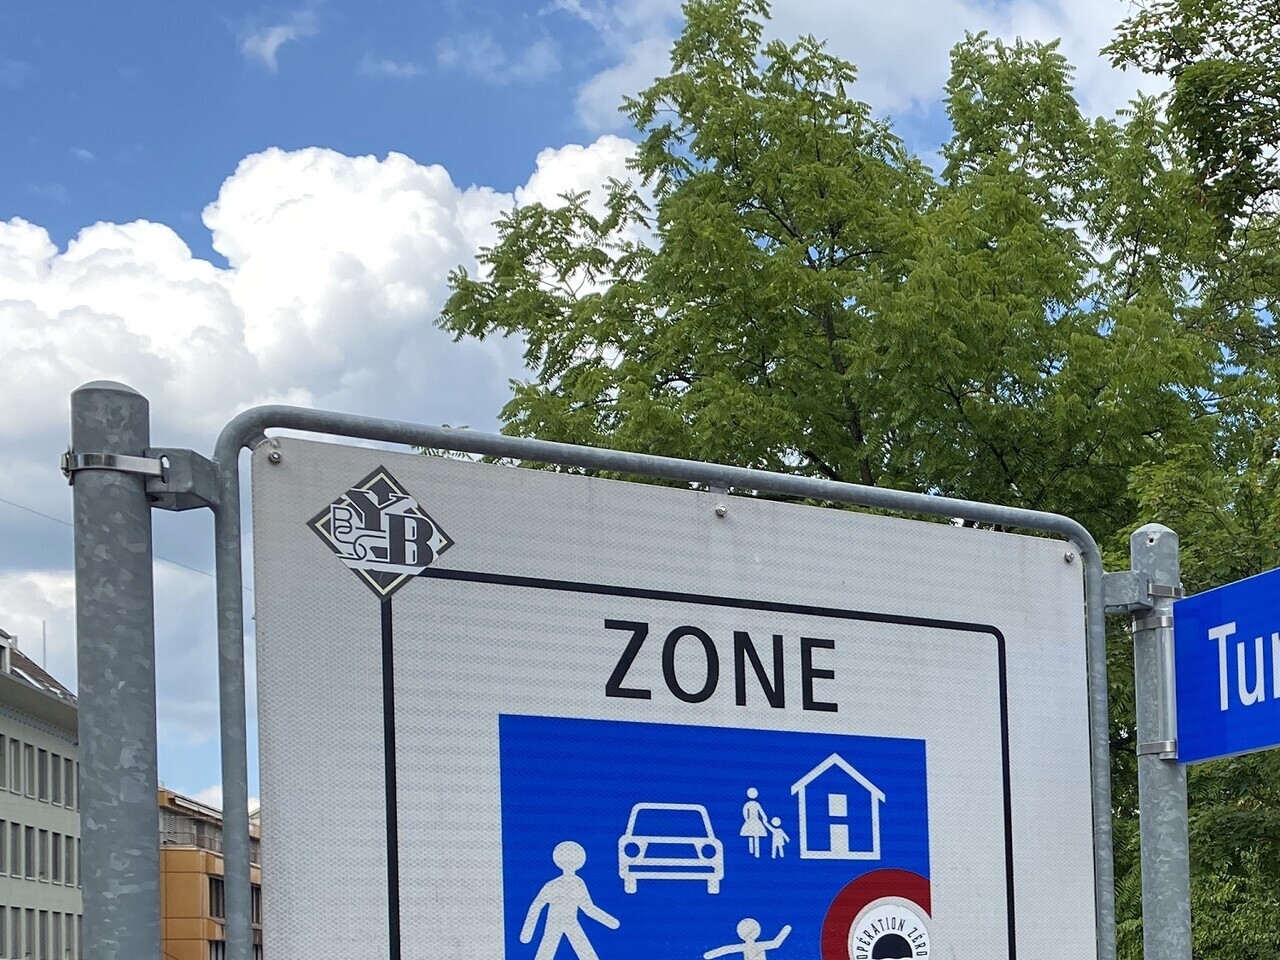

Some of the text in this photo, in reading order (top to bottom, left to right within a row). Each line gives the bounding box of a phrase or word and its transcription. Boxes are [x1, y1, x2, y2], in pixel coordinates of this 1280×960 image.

[604, 618, 839, 713] ZONE
[856, 917, 928, 960] OPÉRATION ZÉRO
